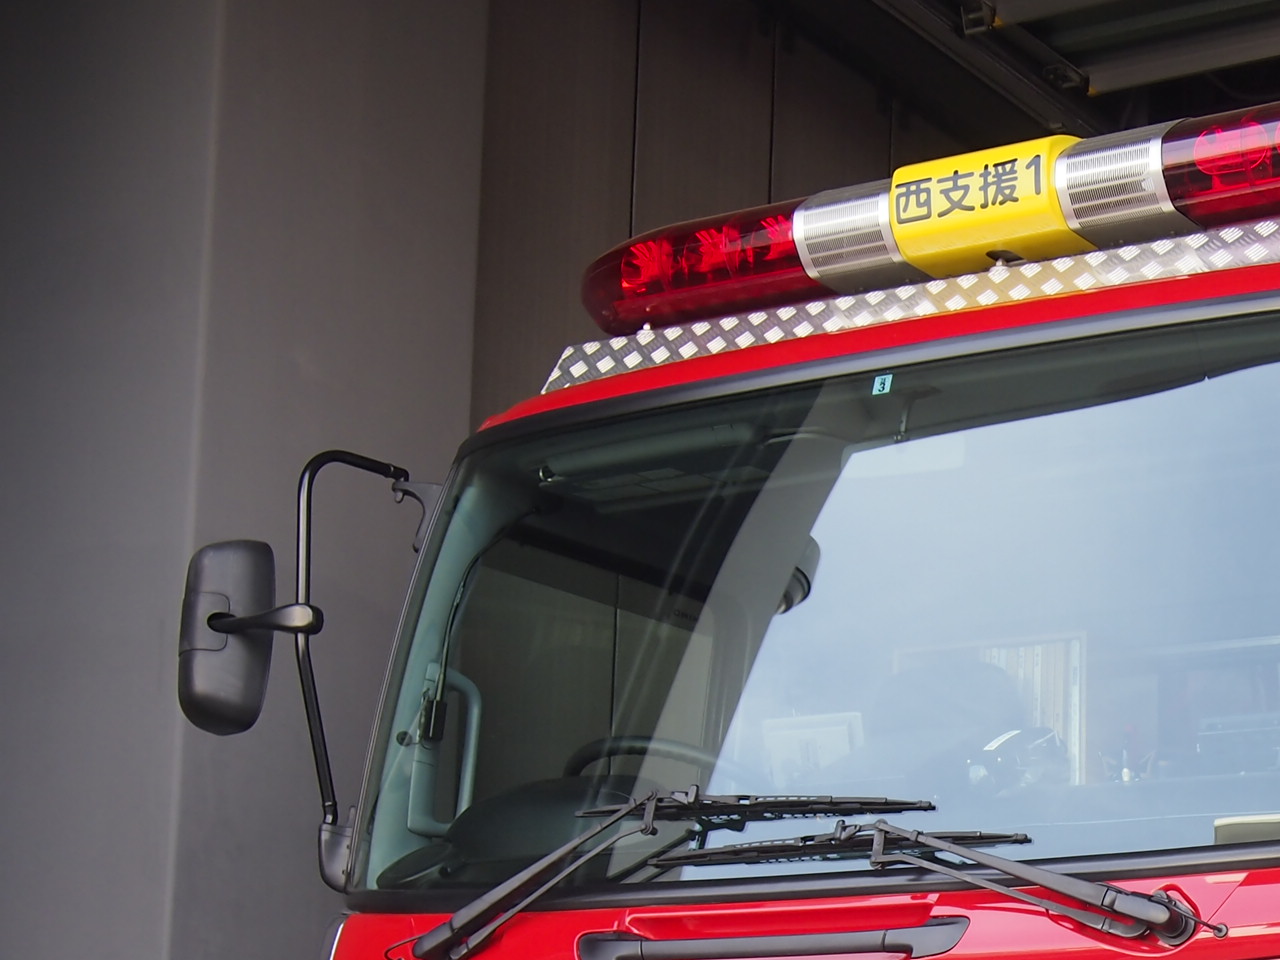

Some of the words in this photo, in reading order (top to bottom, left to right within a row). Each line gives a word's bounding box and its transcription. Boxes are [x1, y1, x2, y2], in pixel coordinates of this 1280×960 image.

[895, 154, 1041, 224] 西支援1
[878, 382, 886, 392] 3
